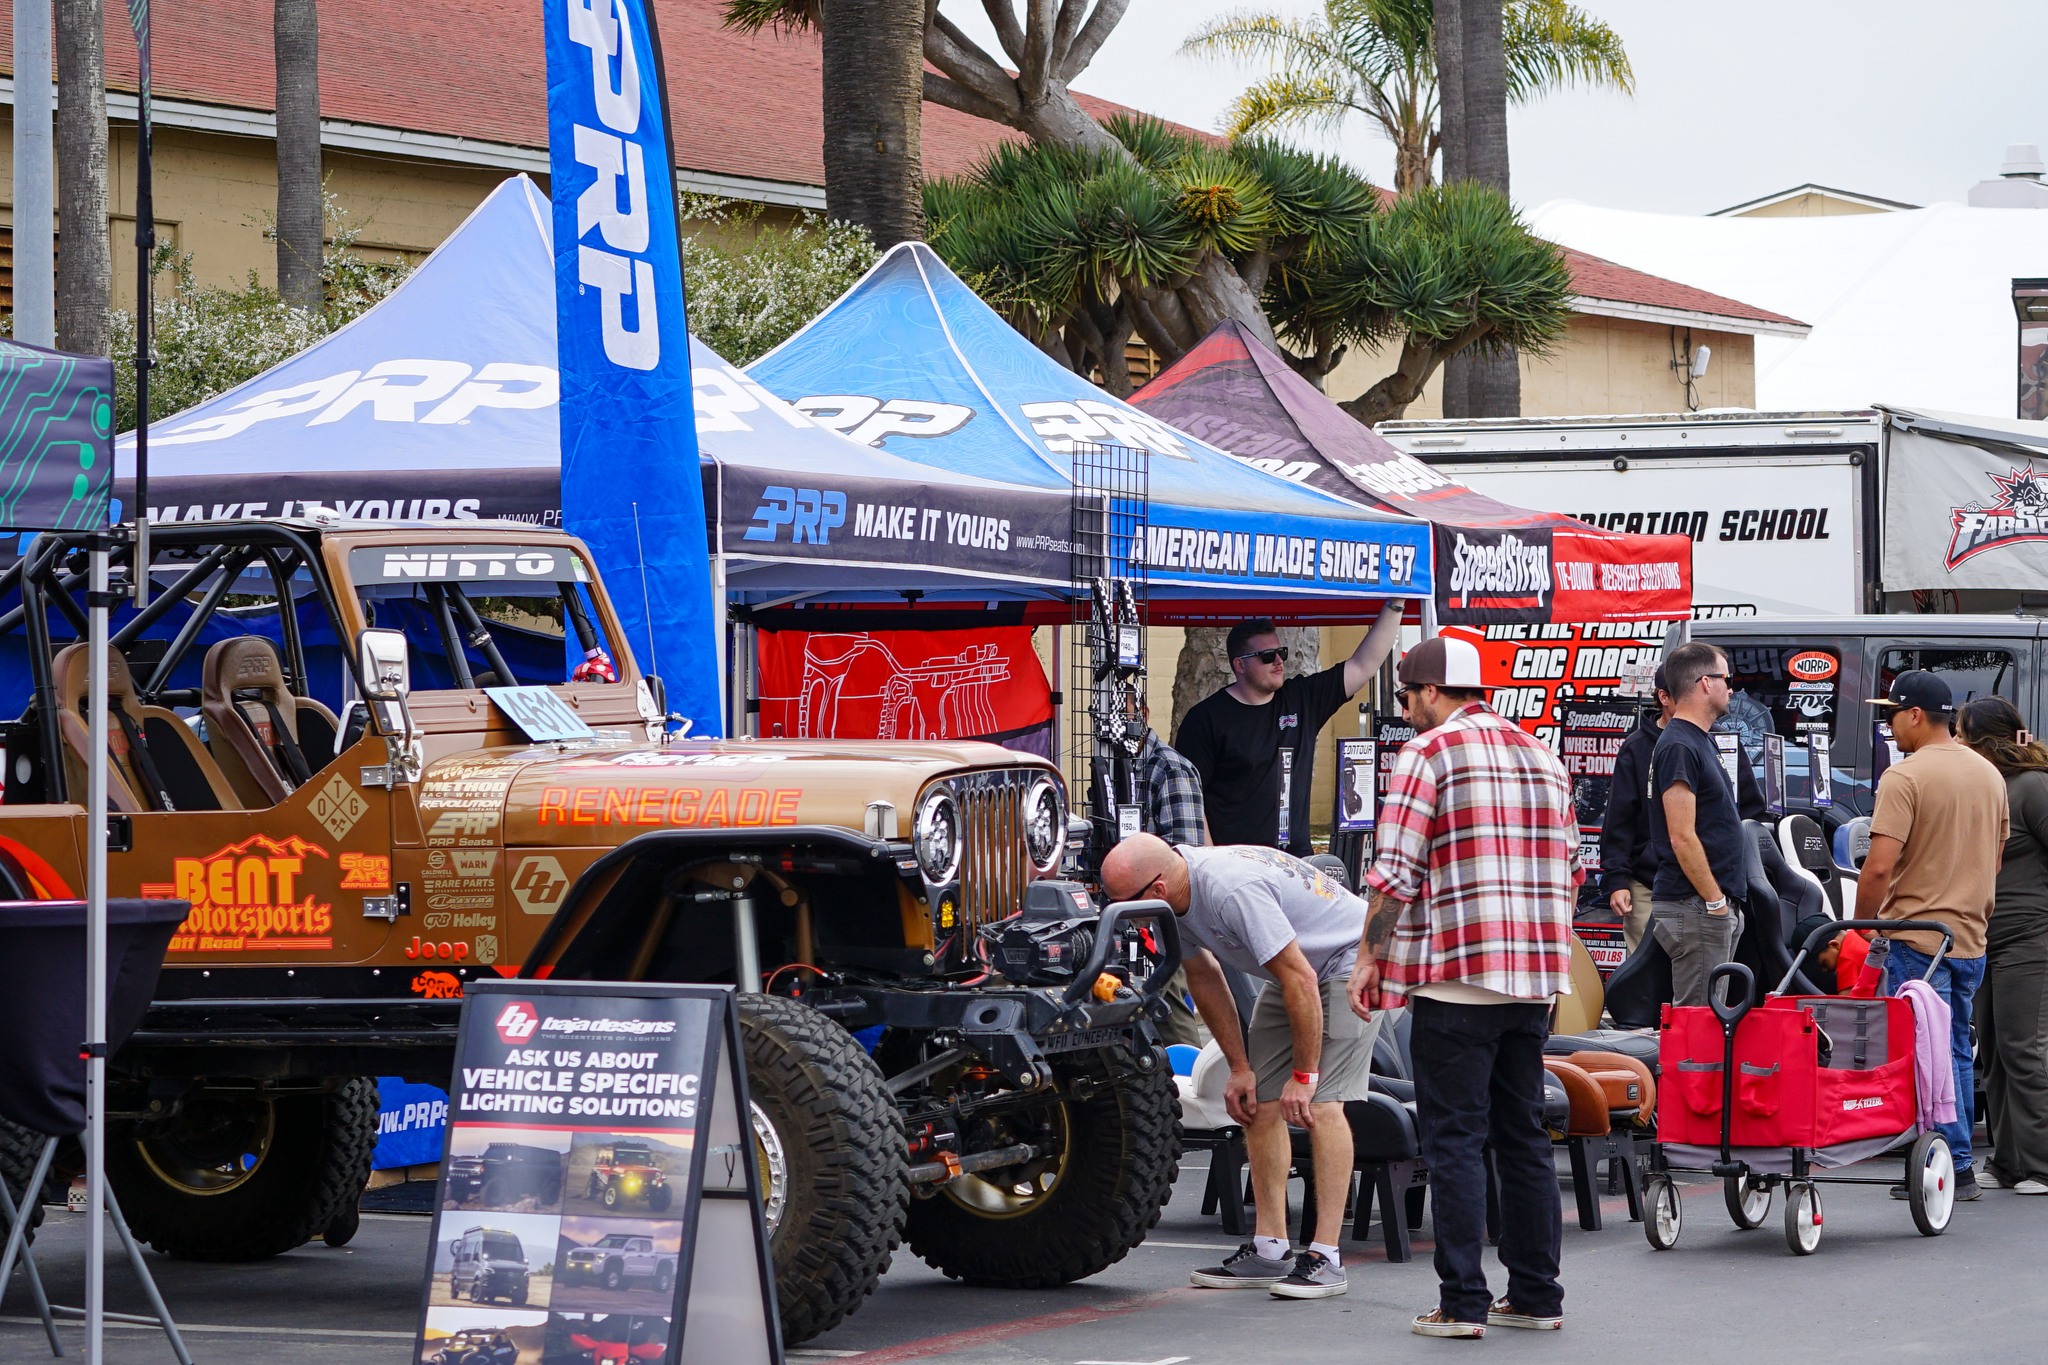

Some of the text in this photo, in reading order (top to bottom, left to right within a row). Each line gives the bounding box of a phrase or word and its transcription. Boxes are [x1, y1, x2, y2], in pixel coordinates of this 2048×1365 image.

[743, 486, 847, 545] PRP
[1719, 508, 1830, 543] SCHOOL
[854, 504, 917, 541] MAKE
[920, 508, 942, 542] IT
[946, 512, 1011, 551] YOURS
[383, 552, 555, 577] NITTO
[1129, 525, 1251, 575] AMERICAN
[1254, 533, 1316, 577] MADE
[1319, 539, 1382, 584] SINCE
[1450, 533, 1551, 608] SpeedStrap
[1555, 561, 1595, 591] TIE-DOWN
[1602, 561, 1641, 593] RECOVERY
[1640, 561, 1682, 592] SOLUTIONS
[1512, 647, 1567, 678] CNC
[1573, 647, 1662, 678] MACHI
[1491, 687, 1546, 718] MIG
[1786, 694, 1833, 714] FOX
[1566, 711, 1635, 732] SpeedStrap
[1564, 737, 1599, 754] WHEEL
[423, 782, 508, 792] METHOD
[419, 800, 503, 810] REVOLUTION
[538, 786, 803, 829] RENEGADE
[426, 811, 500, 836] PRP
[429, 838, 494, 847] PRP Seats
[339, 853, 390, 872] Sign
[460, 860, 488, 869] WARN
[174, 857, 303, 906] BENT
[346, 868, 390, 884] Art
[435, 879, 495, 888] RARE PARTS
[178, 894, 333, 940] otorsports
[453, 913, 497, 931] Holley
[168, 935, 246, 952] Off Road
[405, 936, 469, 962] Jeep
[1607, 951, 1623, 962] LBS
[541, 1017, 676, 1034] baja designs
[1072, 1028, 1120, 1047] CONCEPTS
[505, 1049, 659, 1070] ASK US ABOUT
[462, 1068, 699, 1096] VEHICLE SPECIFIC
[460, 1093, 695, 1118] LIGHTING SOLUTIONS
